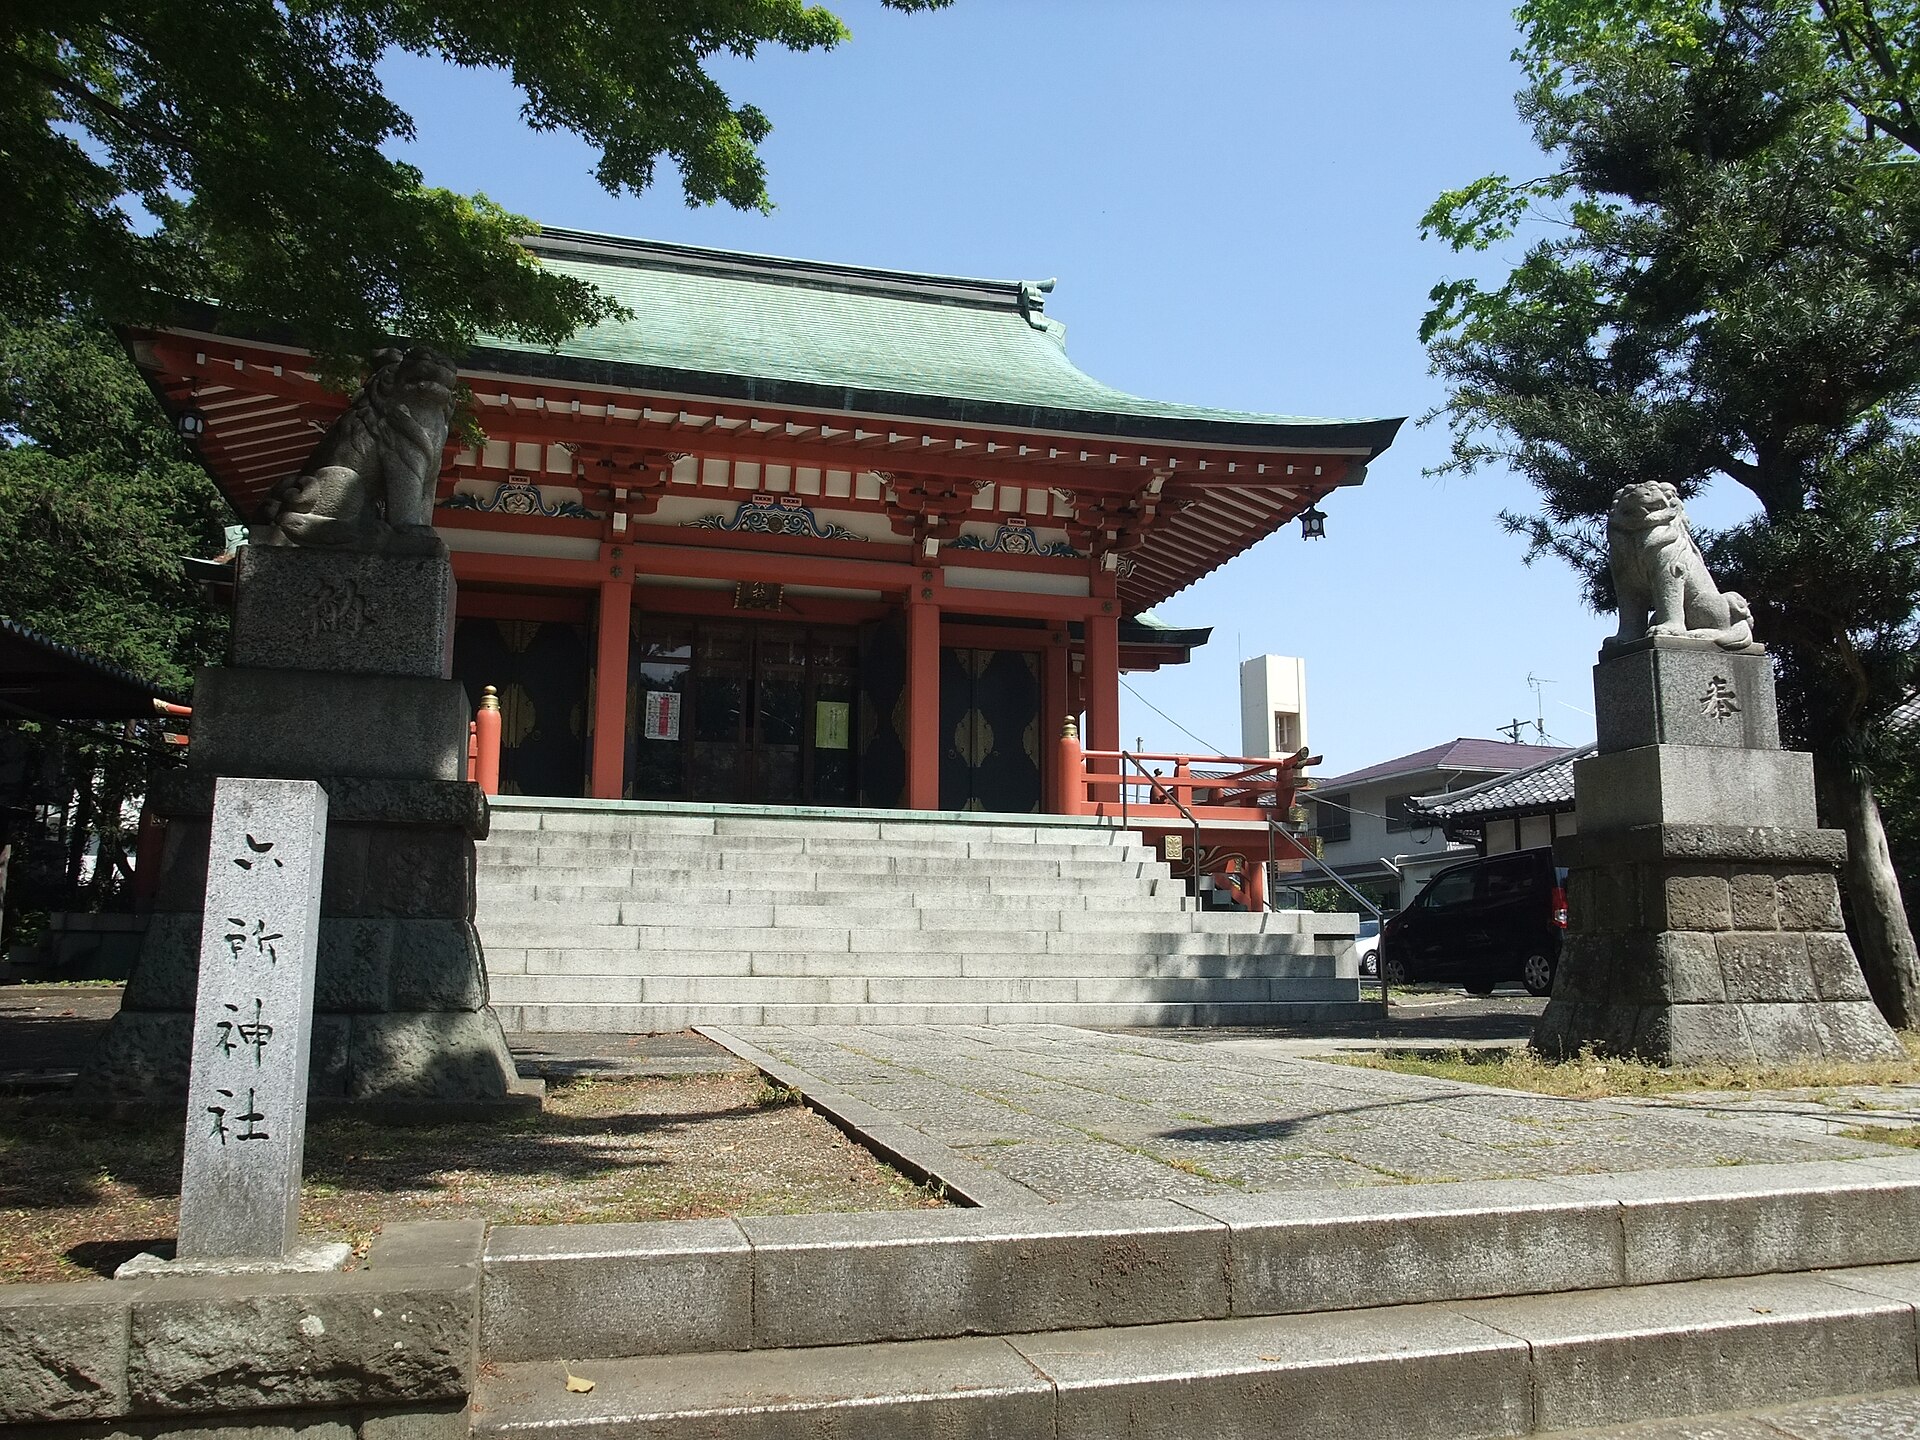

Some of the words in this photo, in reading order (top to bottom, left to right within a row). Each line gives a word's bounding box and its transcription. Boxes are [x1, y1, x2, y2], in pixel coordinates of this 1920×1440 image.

[1699, 675, 1741, 724] 奉
[206, 833, 284, 1146] 六所神社
